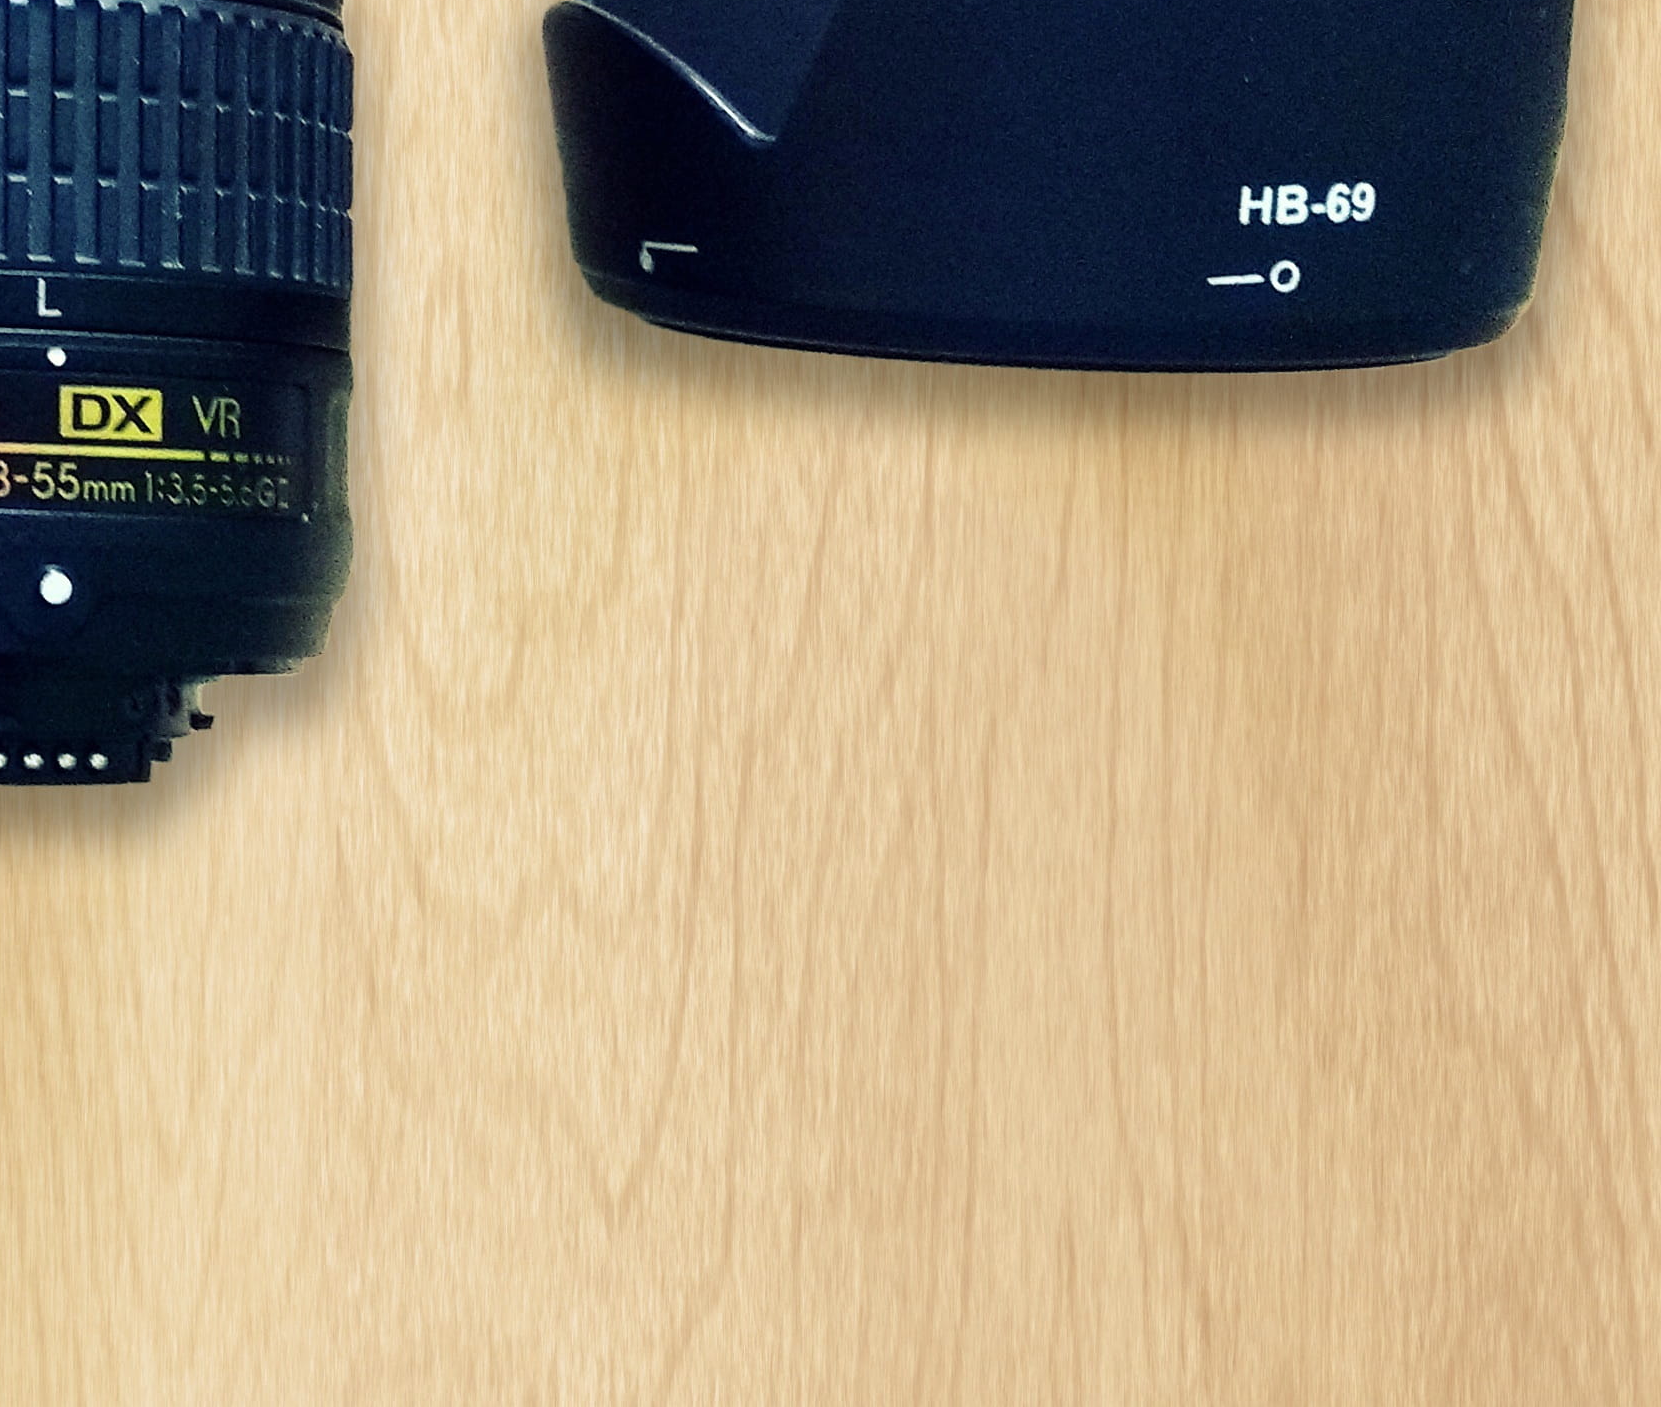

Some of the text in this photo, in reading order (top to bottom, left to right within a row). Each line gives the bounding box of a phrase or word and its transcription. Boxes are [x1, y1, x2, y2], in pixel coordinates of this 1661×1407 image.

[1238, 181, 1377, 226] HB-69
[37, 277, 63, 317] L
[71, 392, 153, 435] DX
[191, 394, 242, 440] VR
